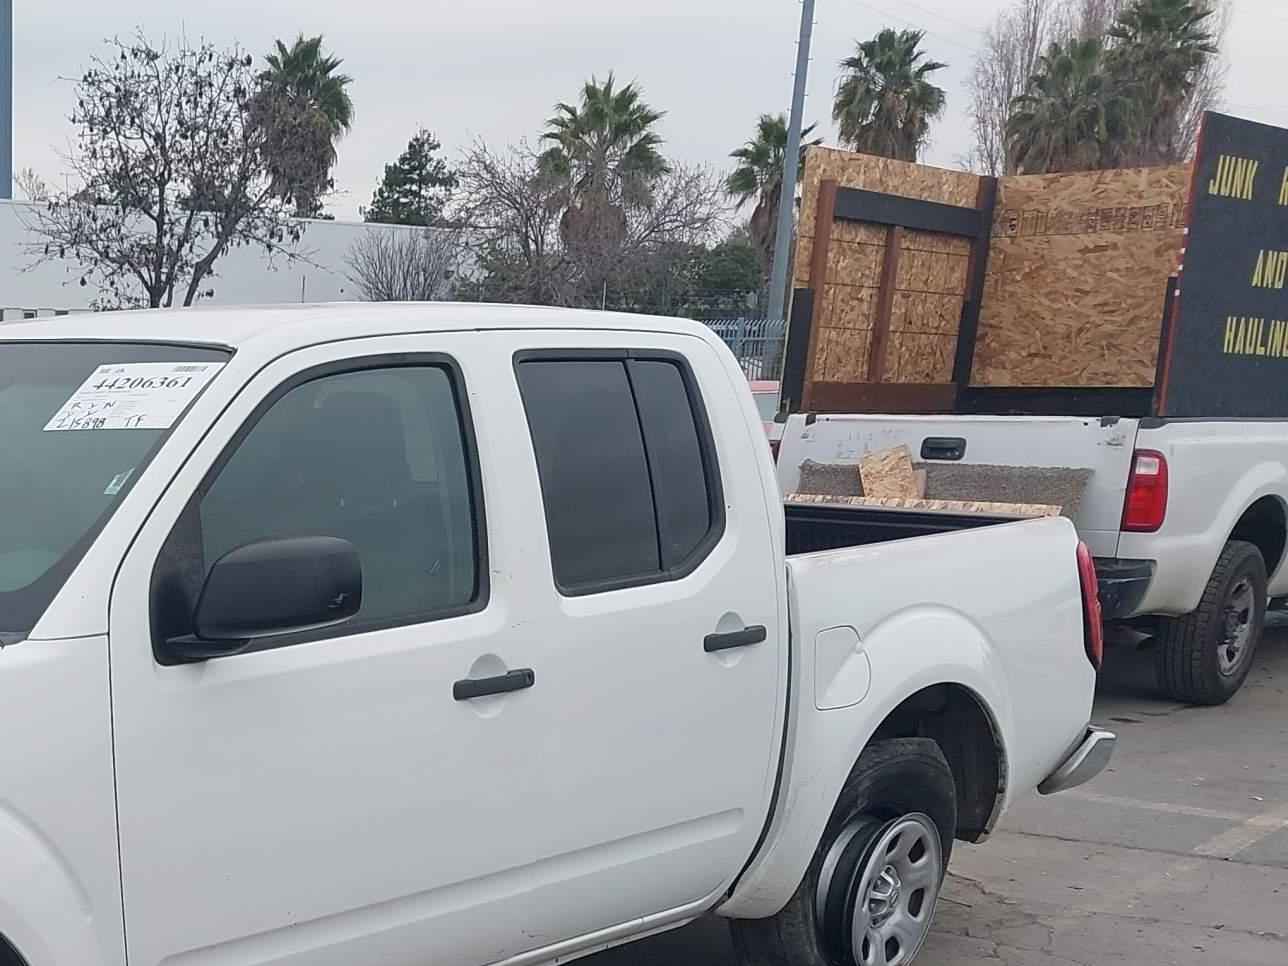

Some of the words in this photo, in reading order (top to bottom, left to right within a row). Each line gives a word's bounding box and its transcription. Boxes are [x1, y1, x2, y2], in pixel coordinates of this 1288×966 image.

[1208, 154, 1258, 200] JUNK
[1252, 249, 1288, 289] AND
[92, 376, 193, 390] 44206361
